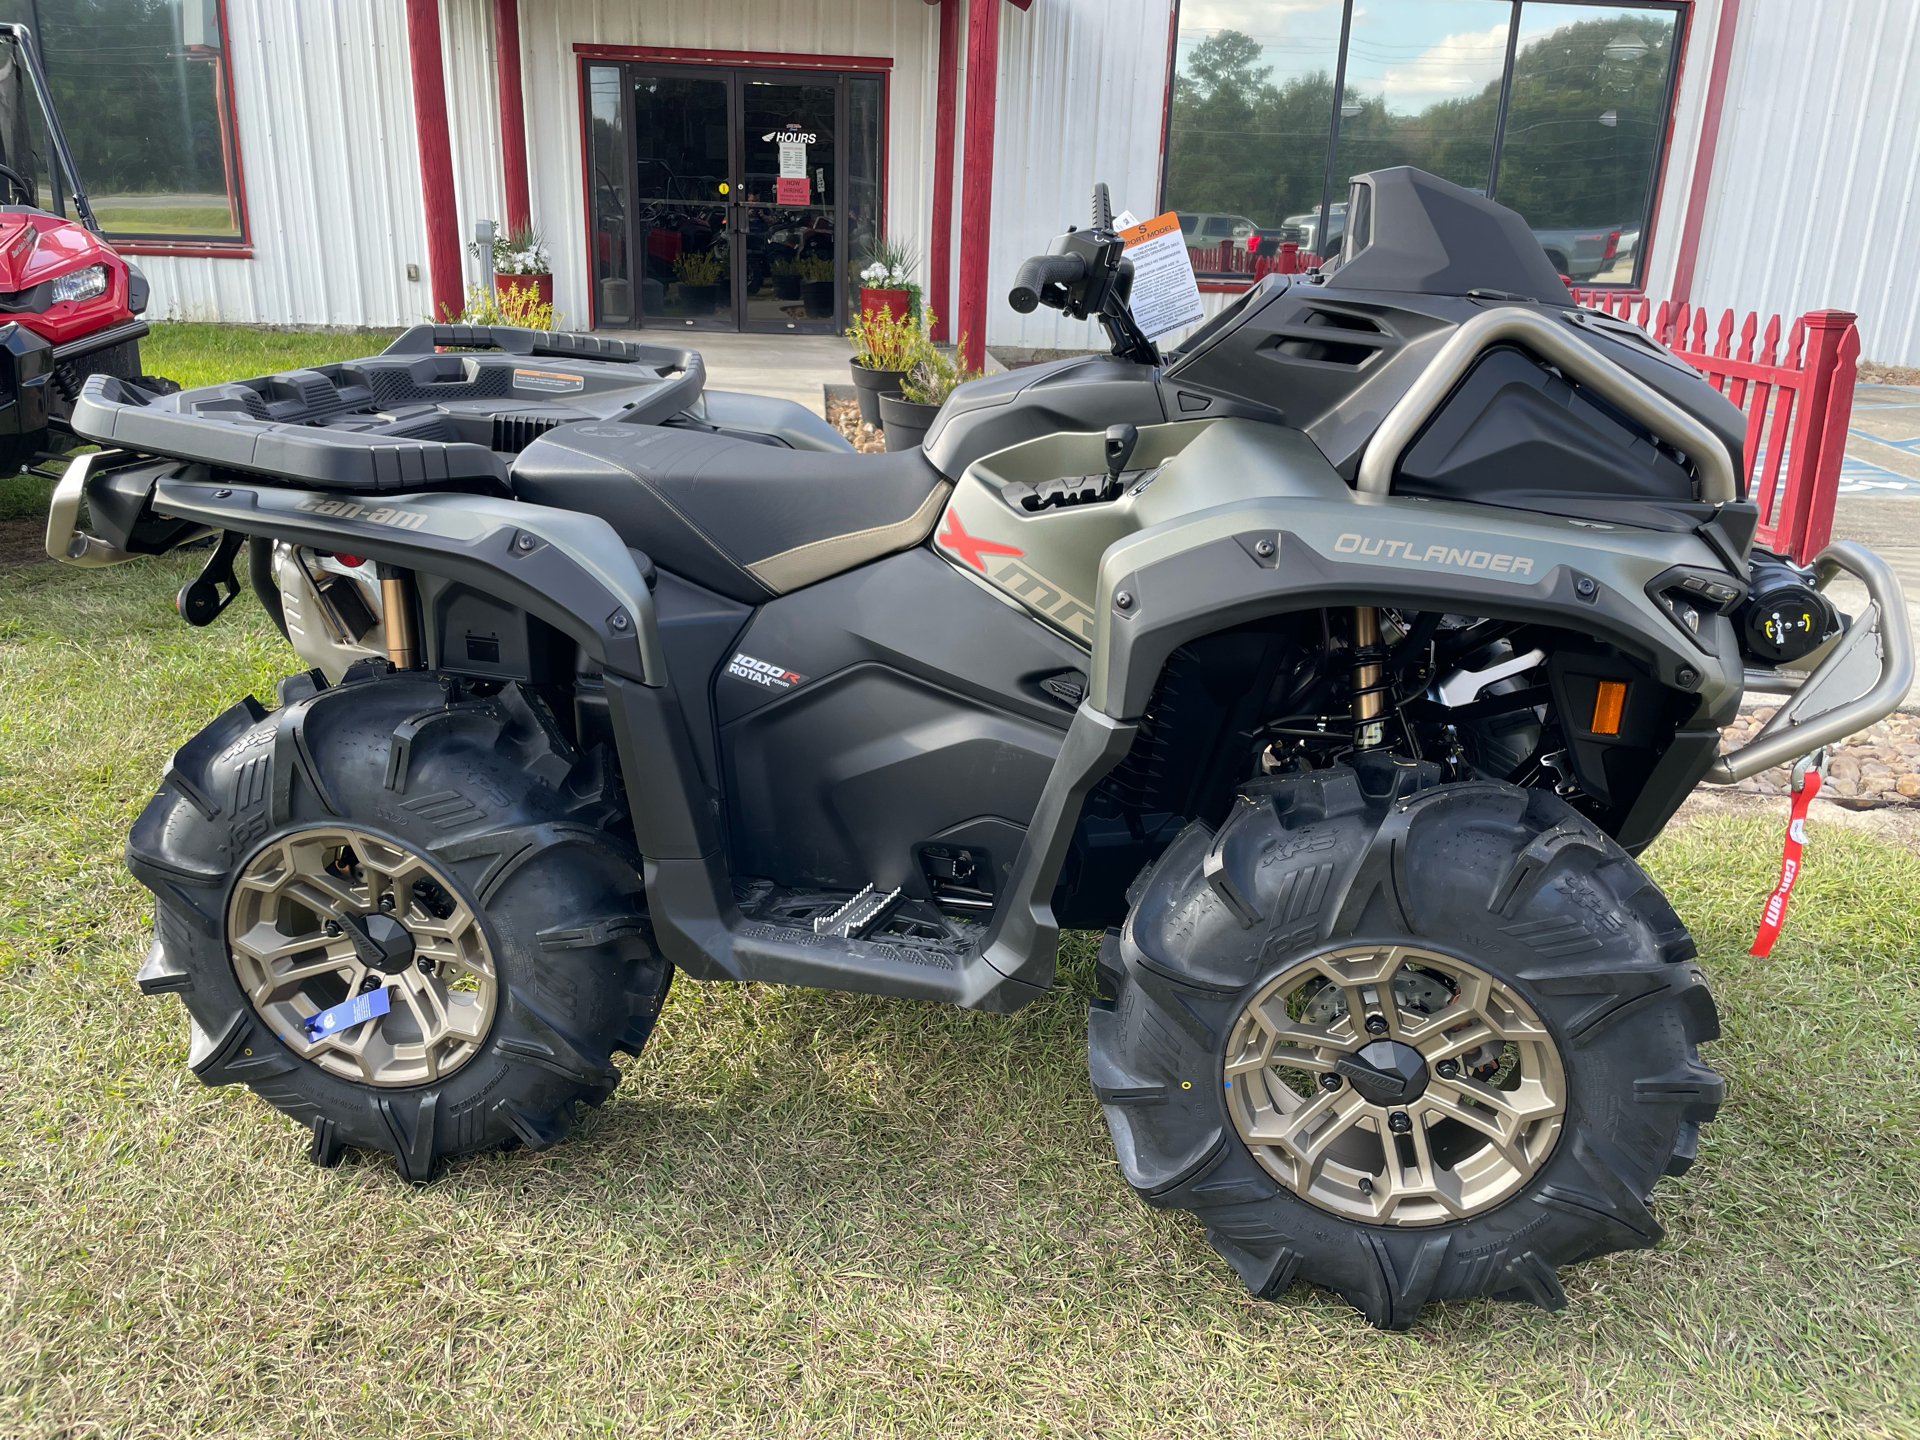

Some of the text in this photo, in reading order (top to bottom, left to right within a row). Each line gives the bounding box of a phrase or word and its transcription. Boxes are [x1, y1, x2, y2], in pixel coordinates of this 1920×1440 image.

[776, 131, 817, 144] HOURS
[783, 187, 804, 195] HIRING
[1138, 224, 1147, 234] S
[1146, 224, 1175, 239] MODEL
[294, 499, 428, 530] can-am
[1334, 533, 1534, 575] OUTLANDER
[728, 662, 790, 688] ROTAX POWER
[733, 653, 800, 684] 1000R
[216, 809, 269, 868] XPS
[1765, 858, 1796, 927] can-am
[1244, 922, 1319, 978] XPS
